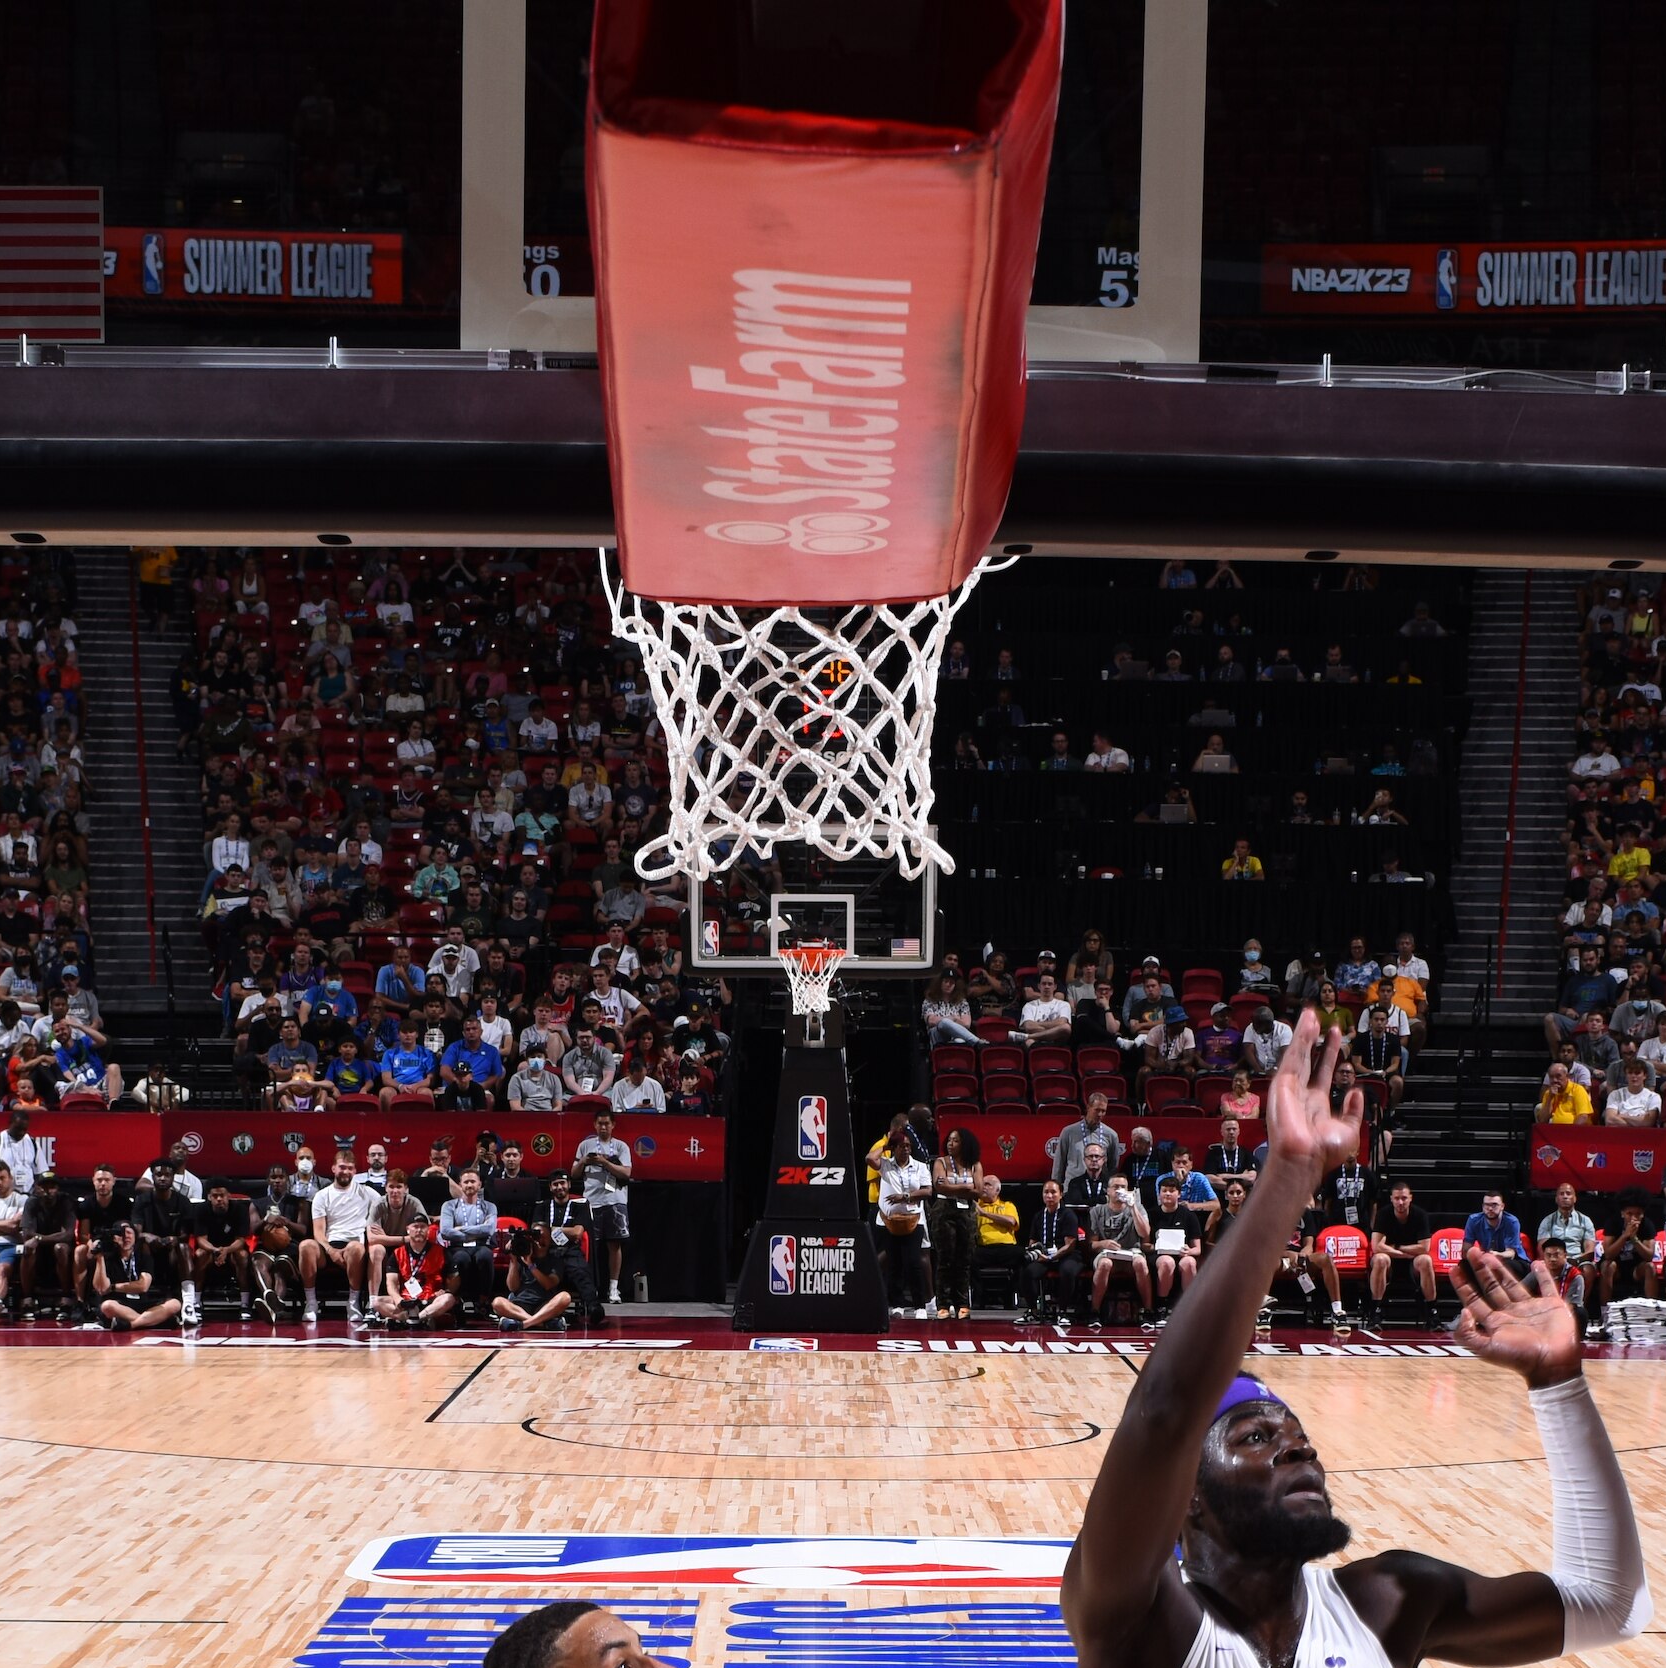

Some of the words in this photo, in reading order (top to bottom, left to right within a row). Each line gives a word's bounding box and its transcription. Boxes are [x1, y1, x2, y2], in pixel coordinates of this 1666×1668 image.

[183, 237, 283, 296] SUMMER
[290, 241, 374, 300] LEAGUE
[1290, 267, 1411, 293] NBA2K23
[1476, 250, 1577, 309] SUMMER
[802, 1145, 816, 1157] NBA
[776, 1166, 846, 1186] 2K23
[800, 1248, 855, 1272] SUMMER
[799, 1271, 846, 1295] LEAGUE
[876, 1339, 1158, 1353] SUMME
